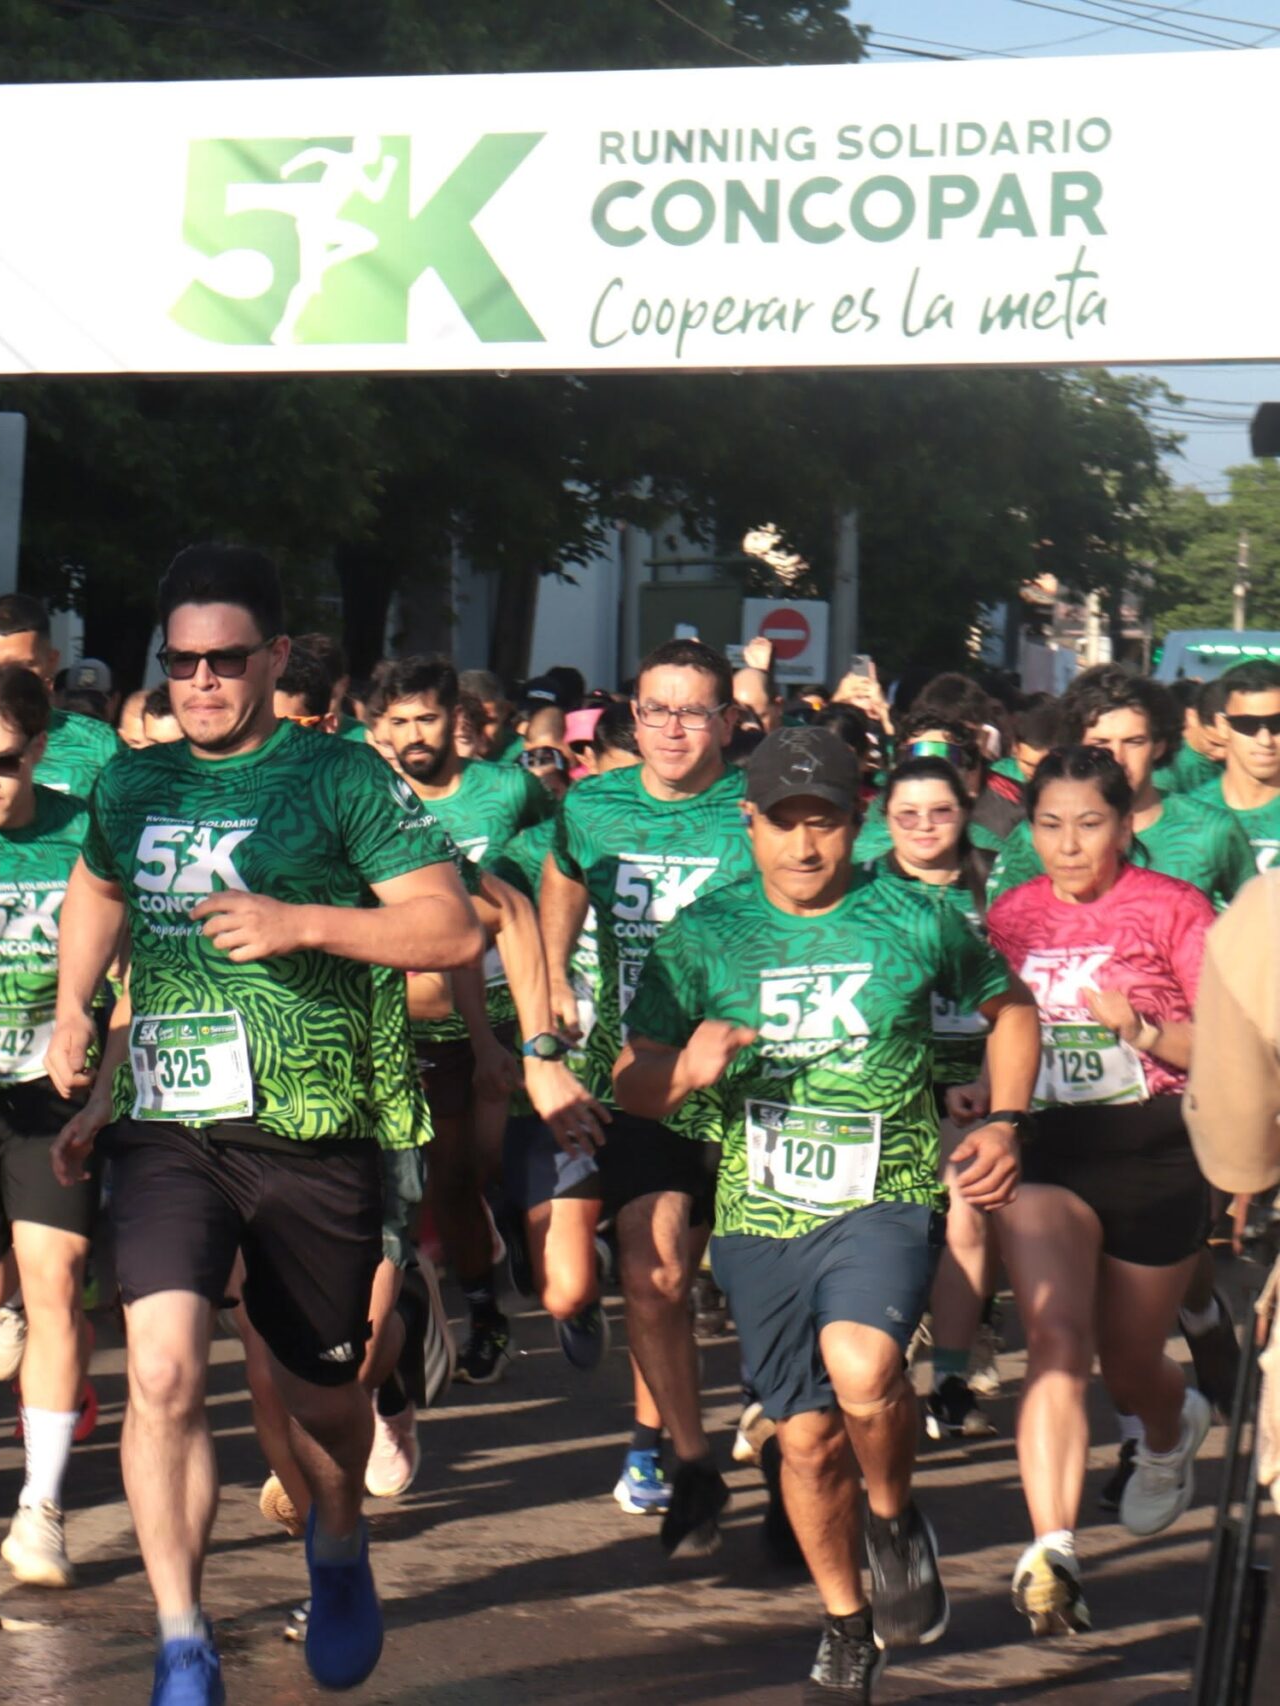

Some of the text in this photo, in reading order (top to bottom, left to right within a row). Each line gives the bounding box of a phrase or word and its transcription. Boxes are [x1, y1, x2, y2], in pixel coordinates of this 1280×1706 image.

[600, 116, 1113, 165] RUNNING SOLIDARIO
[167, 132, 547, 345] 5K
[590, 170, 1109, 248] CONCOPAR
[590, 276, 815, 358] Cooperar
[830, 288, 881, 335] es
[978, 244, 1109, 340] meta
[133, 825, 255, 894] 5K
[611, 862, 718, 922] 5K
[613, 922, 663, 938] CONC
[758, 973, 873, 1041] 5K
[158, 1048, 211, 1088] 325
[1059, 1051, 1104, 1083] 129
[782, 1139, 836, 1181] 120
